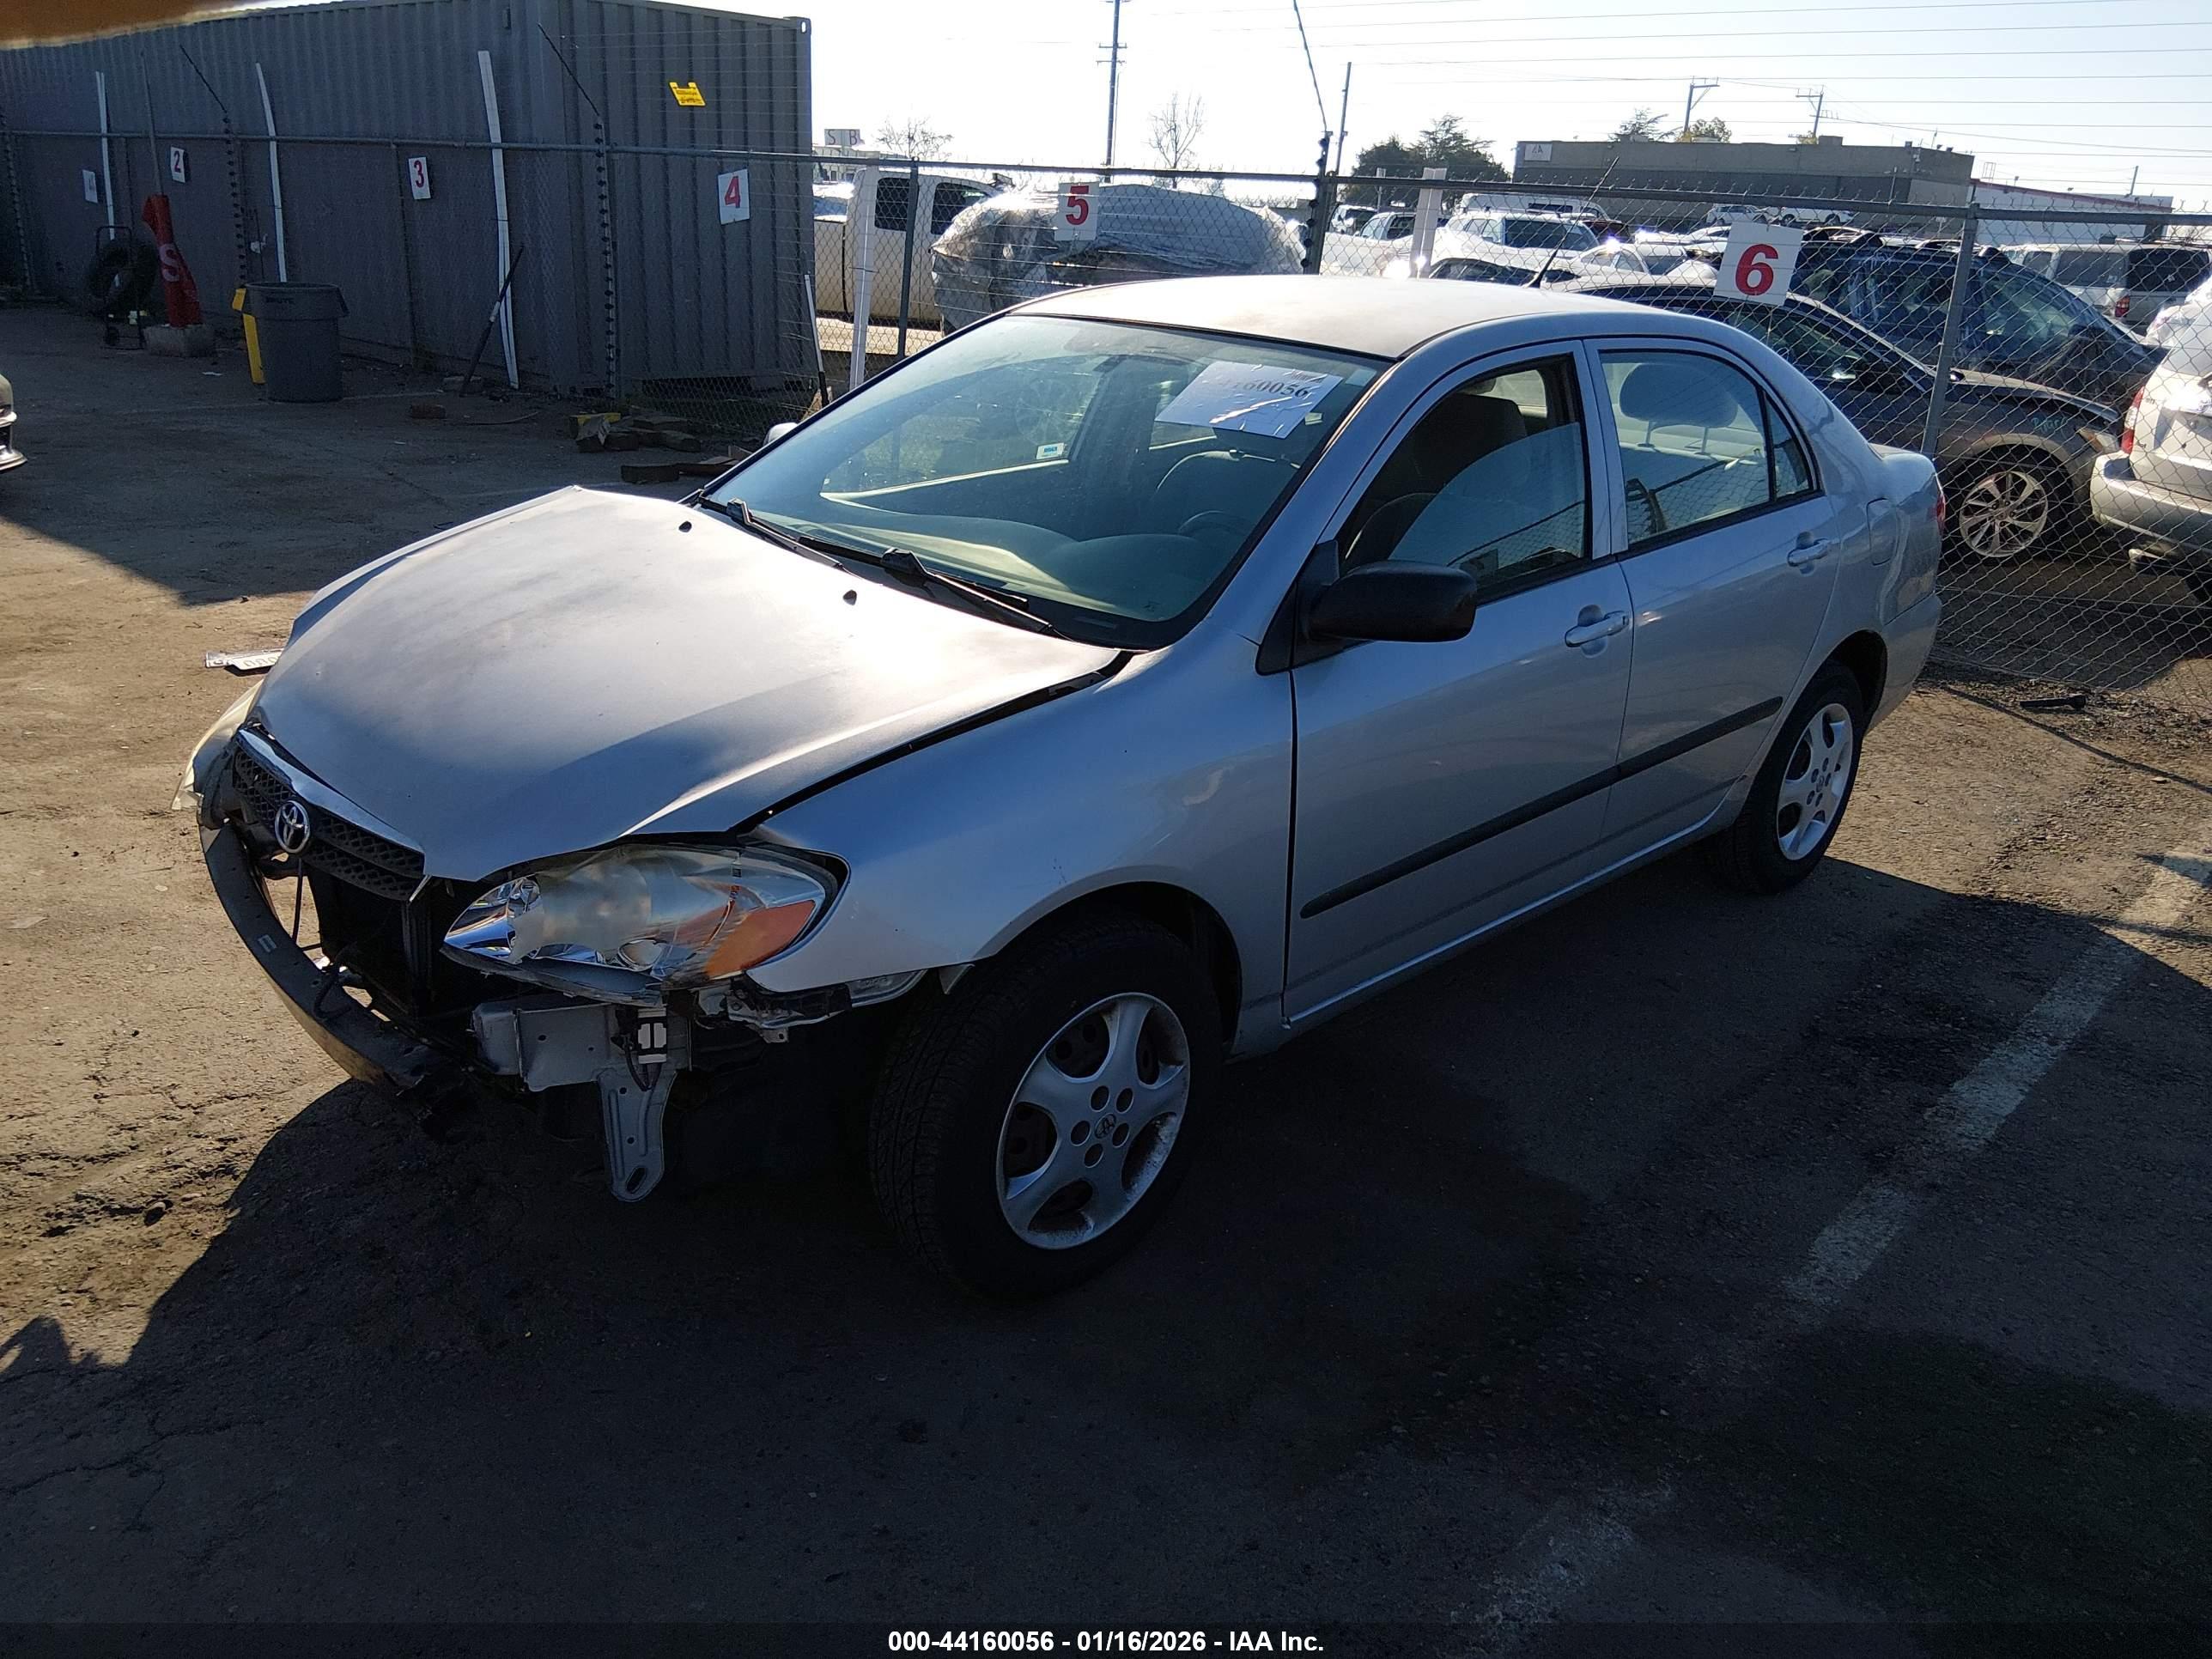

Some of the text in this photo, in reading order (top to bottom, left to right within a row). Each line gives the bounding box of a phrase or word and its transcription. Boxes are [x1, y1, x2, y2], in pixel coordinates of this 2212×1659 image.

[174, 150, 181, 173] 2
[414, 160, 424, 188] 3
[724, 176, 741, 209] 4
[1066, 185, 1089, 225] 5
[1735, 244, 1778, 296] 6
